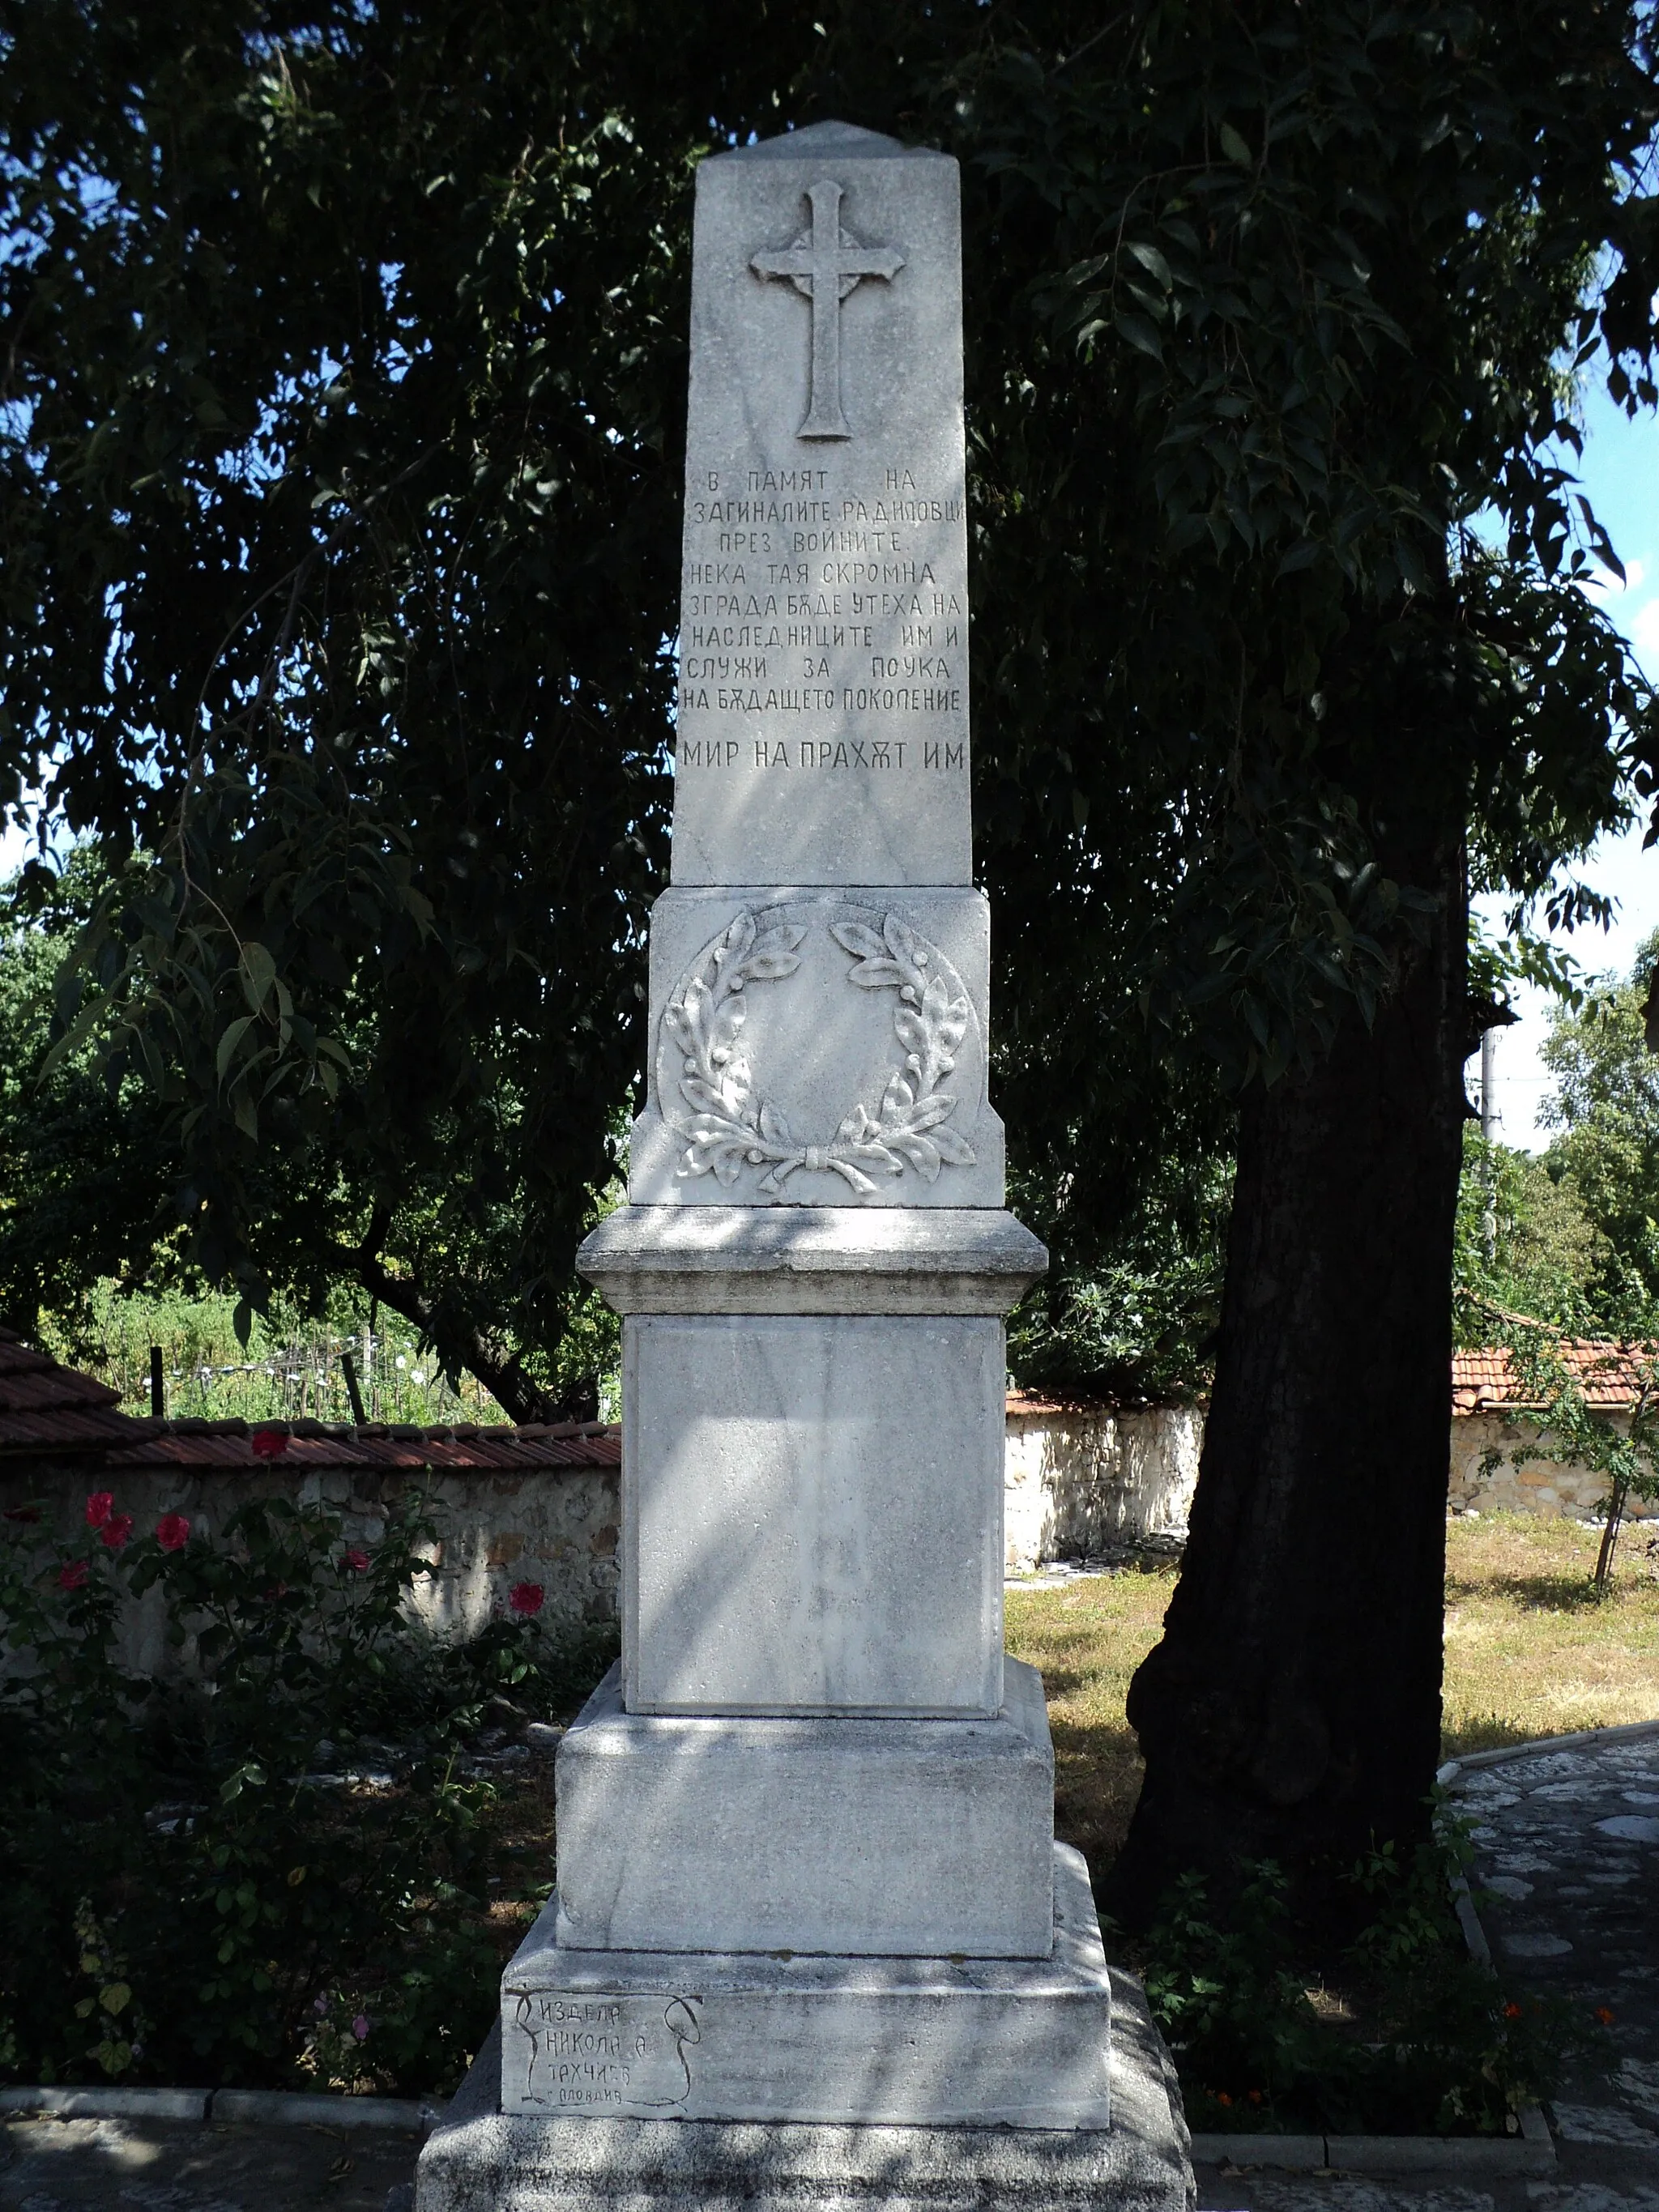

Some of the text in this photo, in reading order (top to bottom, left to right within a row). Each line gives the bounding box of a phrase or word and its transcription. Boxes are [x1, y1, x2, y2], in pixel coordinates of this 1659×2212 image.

[708, 469, 916, 492] В ПАМЯТ НА
[693, 501, 964, 525] ЗАГИНАЛИТЕ РАДИЛОВЦИ
[719, 532, 771, 552] ПРЕЗ
[690, 561, 936, 585] НЕКА ТАЯ СКРОМНА
[690, 595, 778, 620] ЗГРАДА
[853, 593, 923, 616] УТЕХА
[934, 594, 961, 616] НА
[693, 625, 957, 649] НАСЛЕДНИЦИТЕ ИМ И
[687, 657, 950, 680] СЛУЖИ ЗА ПОУКА
[684, 689, 710, 710] НА
[843, 688, 960, 712] ПОКОЛЕНИЕ
[684, 741, 740, 767] МИР
[754, 741, 790, 767] НА
[923, 742, 963, 769] ИМ
